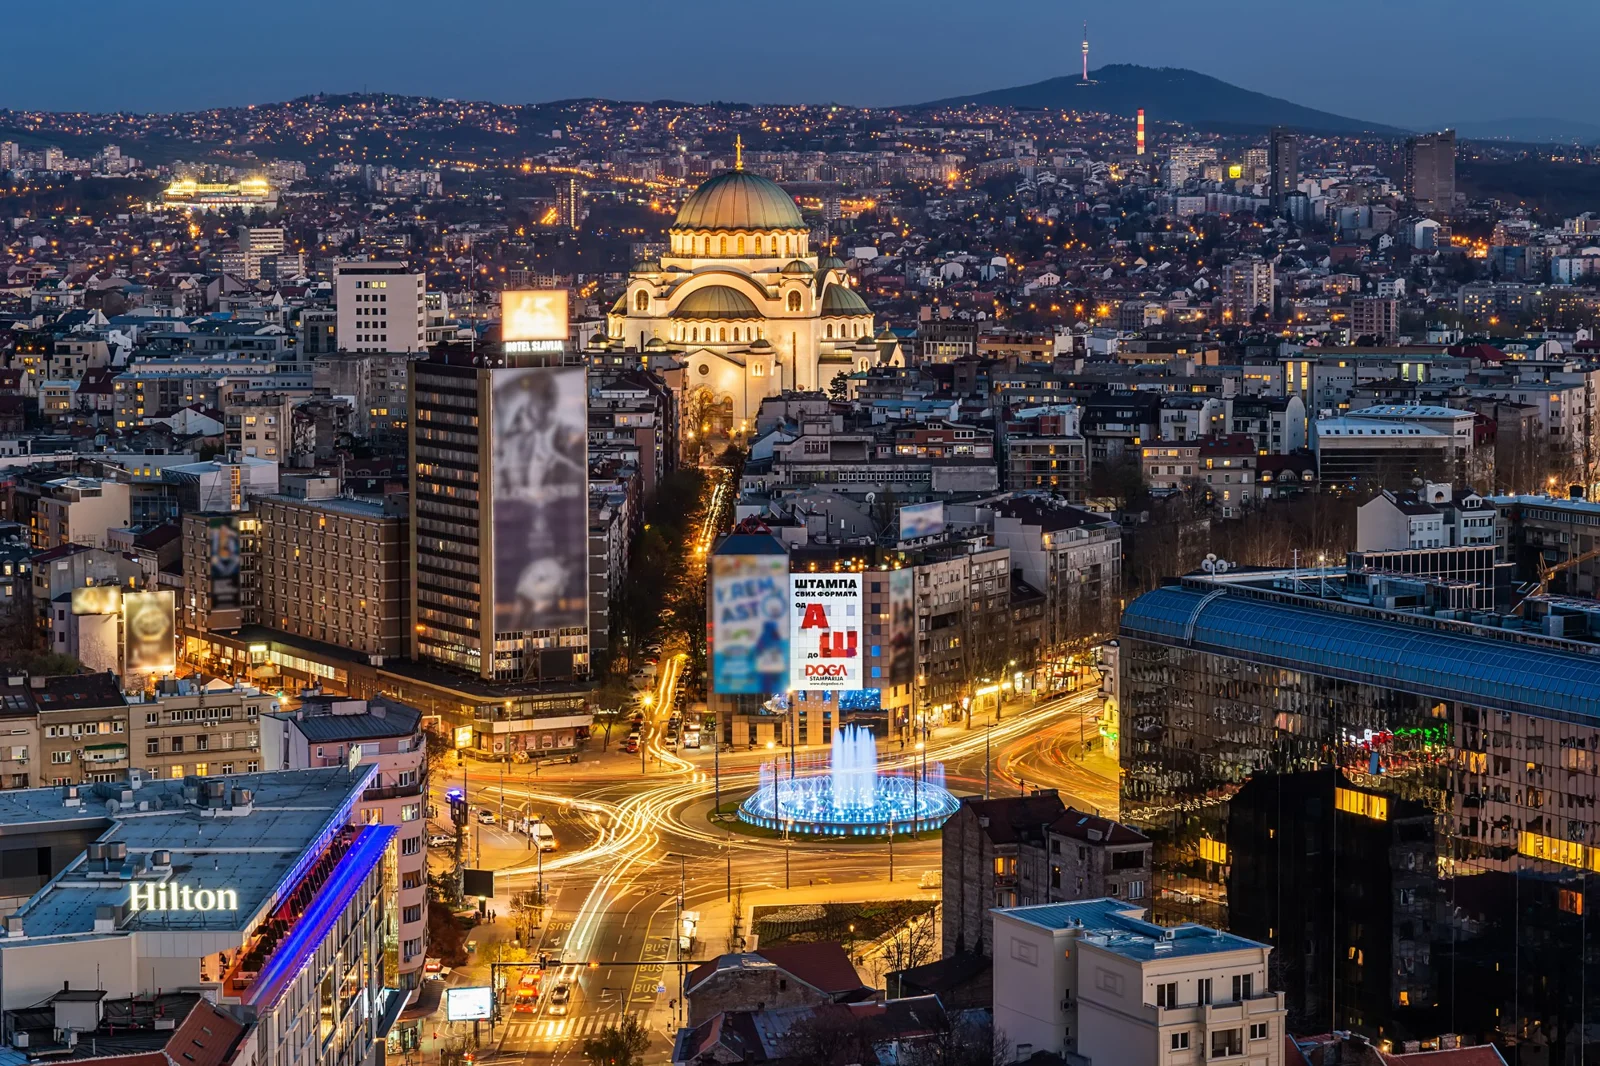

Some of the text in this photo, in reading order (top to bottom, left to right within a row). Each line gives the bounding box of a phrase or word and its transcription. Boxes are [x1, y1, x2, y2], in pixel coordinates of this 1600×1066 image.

[505, 340, 563, 352] HOTEL SLAVIJA
[795, 579, 857, 588] ШТАМПА
[801, 603, 829, 629] А
[819, 631, 858, 658] Ш
[805, 664, 848, 676] DOGA
[129, 881, 238, 911] Hilton
[644, 943, 669, 953] BUS
[639, 964, 664, 972] BUS
[634, 983, 658, 993] BUS
